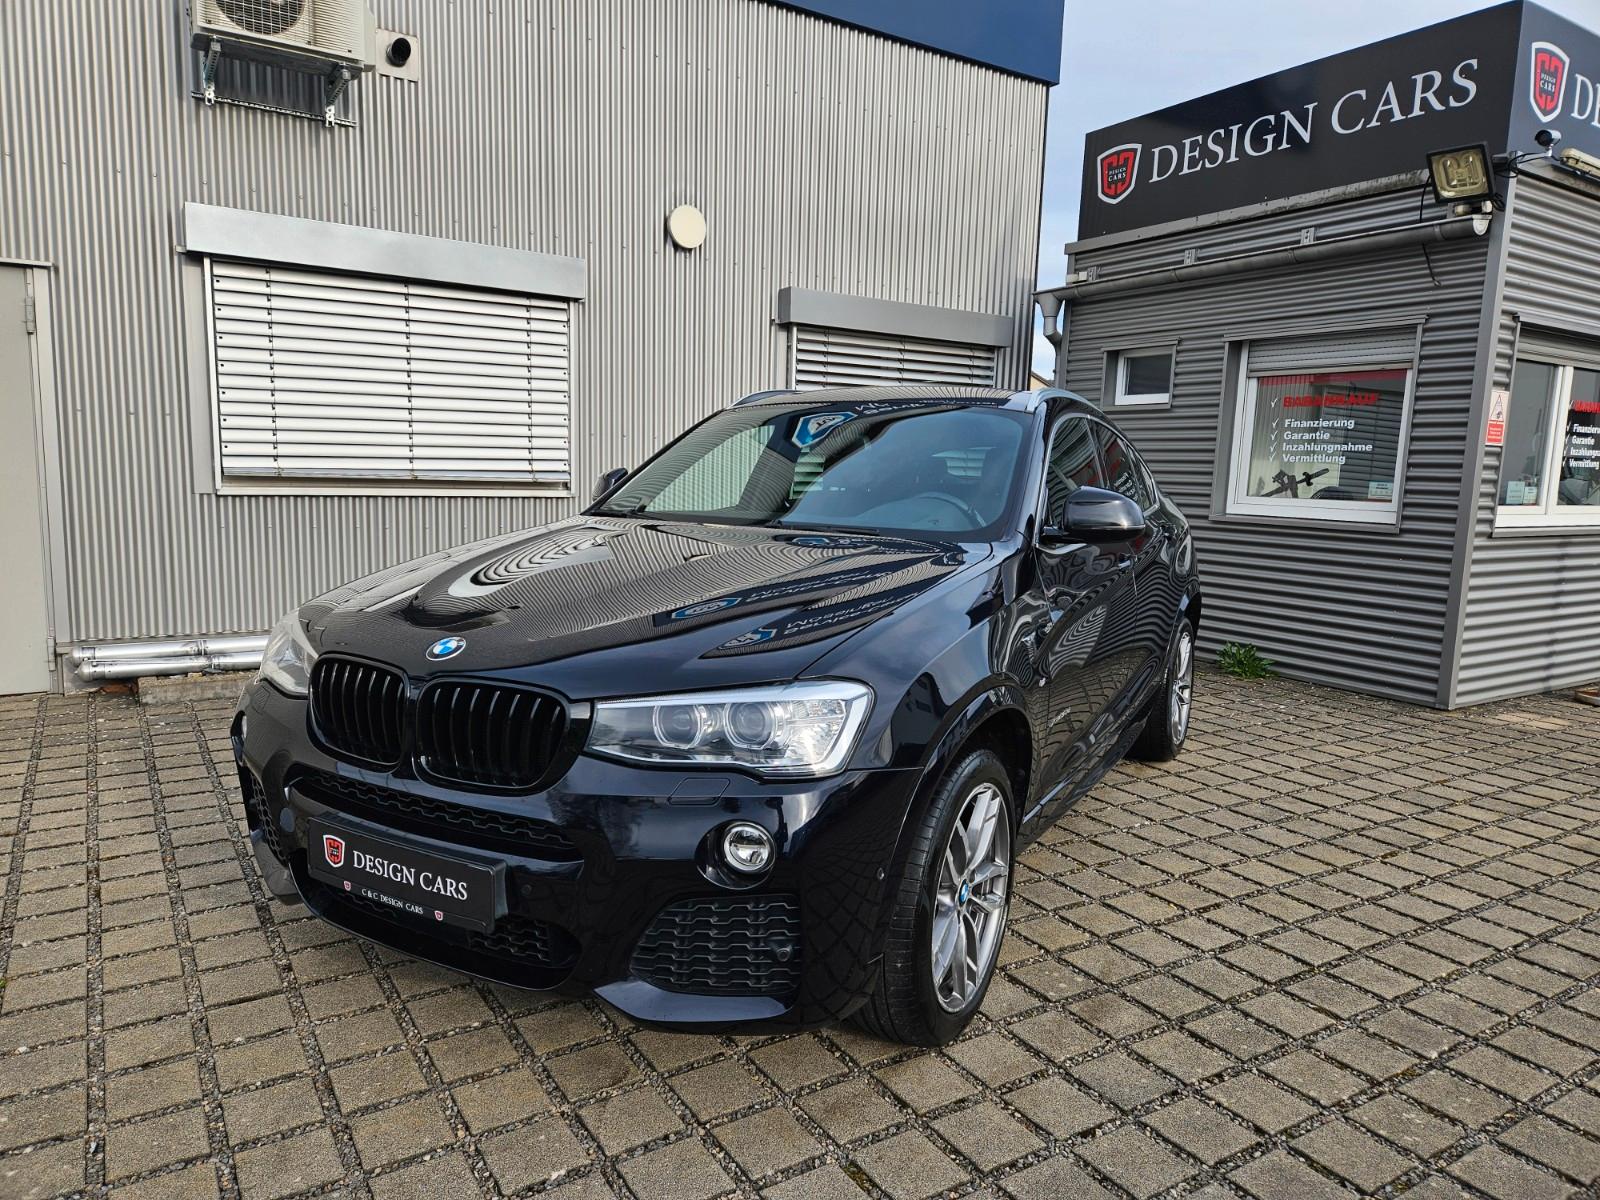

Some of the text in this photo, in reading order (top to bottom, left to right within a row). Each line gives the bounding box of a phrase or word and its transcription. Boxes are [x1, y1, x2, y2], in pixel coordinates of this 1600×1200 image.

[1149, 59, 1478, 183] DESIGN CARS
[1108, 172, 1127, 182] CARS
[1284, 419, 1355, 429] Finanzierung
[1283, 431, 1330, 440] Garantie
[1282, 442, 1373, 453] Inzahlungnahme
[1282, 454, 1346, 465] Vermittlung
[353, 850, 468, 900] DESIGN CARS
[361, 888, 367, 896] C
[373, 892, 378, 900] C
[380, 894, 403, 909] DESIGN
[405, 903, 424, 915] CARS
